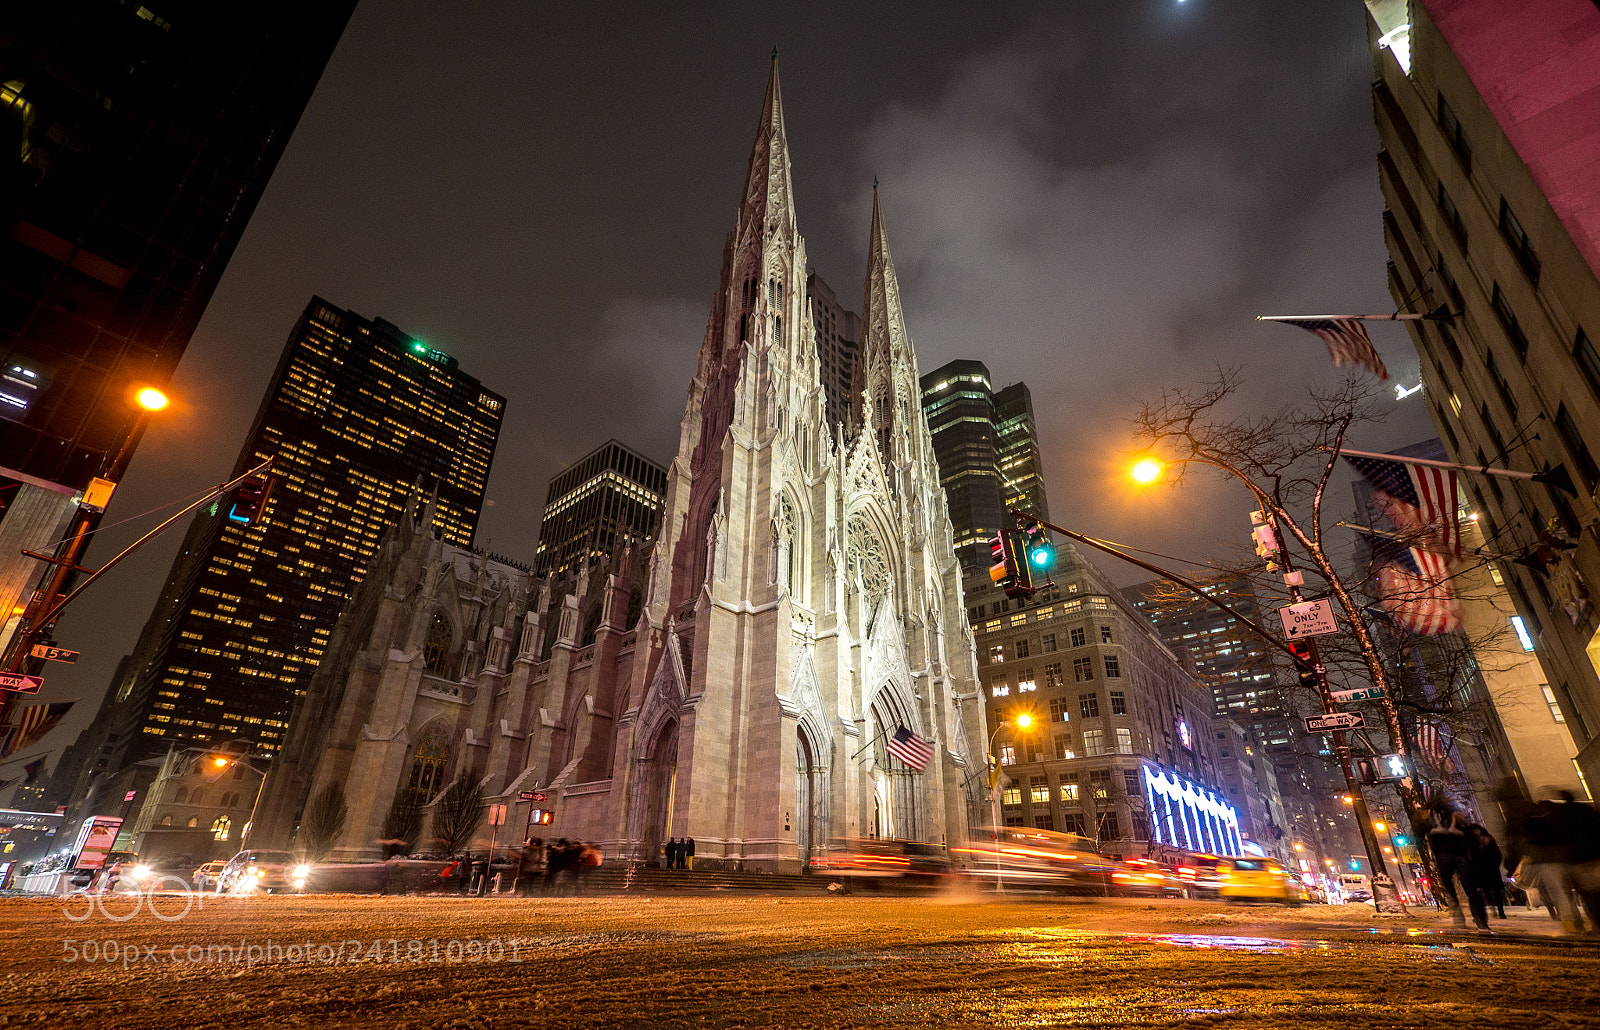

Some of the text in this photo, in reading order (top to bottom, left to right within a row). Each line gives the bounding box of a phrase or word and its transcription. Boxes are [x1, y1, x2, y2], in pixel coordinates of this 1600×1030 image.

[1294, 612, 1319, 623] ONLY
[48, 649, 60, 659] 5
[2, 677, 23, 686] WAY
[1360, 688, 1371, 699] 51
[1311, 716, 1355, 728] ONE WAY
